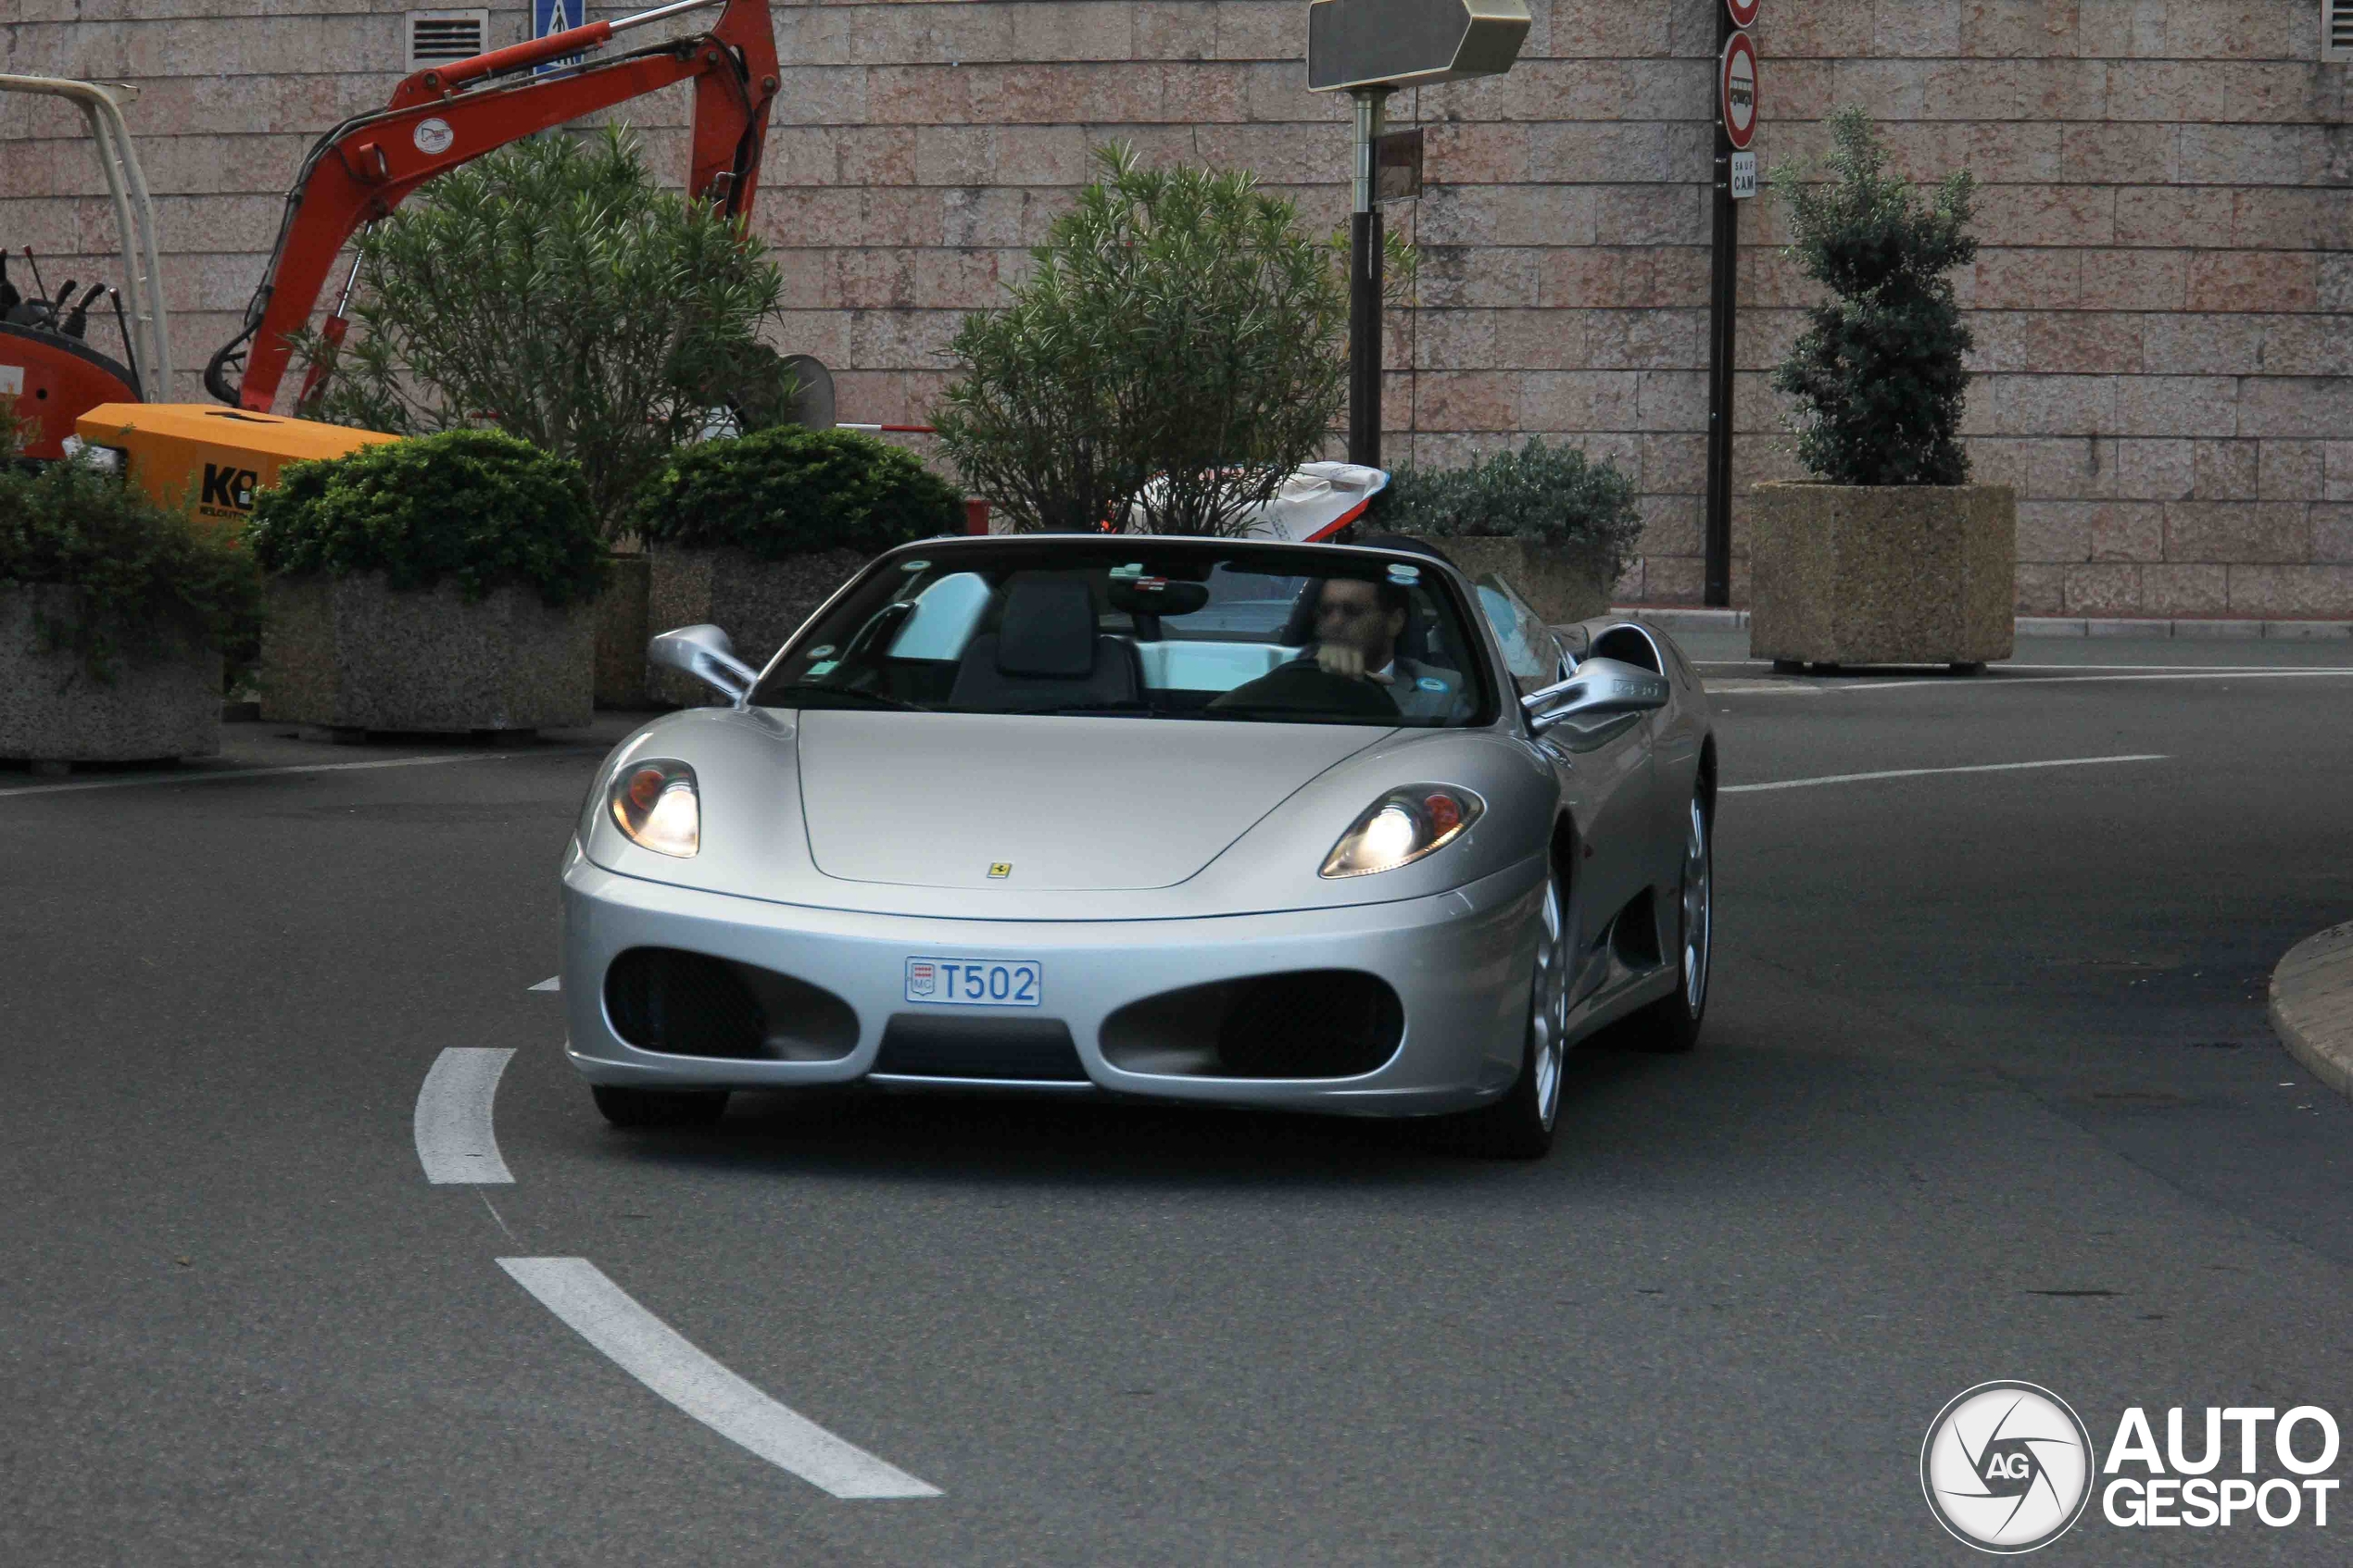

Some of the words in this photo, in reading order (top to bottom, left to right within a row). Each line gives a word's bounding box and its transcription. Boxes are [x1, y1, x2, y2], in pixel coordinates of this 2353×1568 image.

[1735, 161, 1754, 170] SAUF
[1734, 175, 1755, 190] CAM
[941, 964, 1035, 1000] T502
